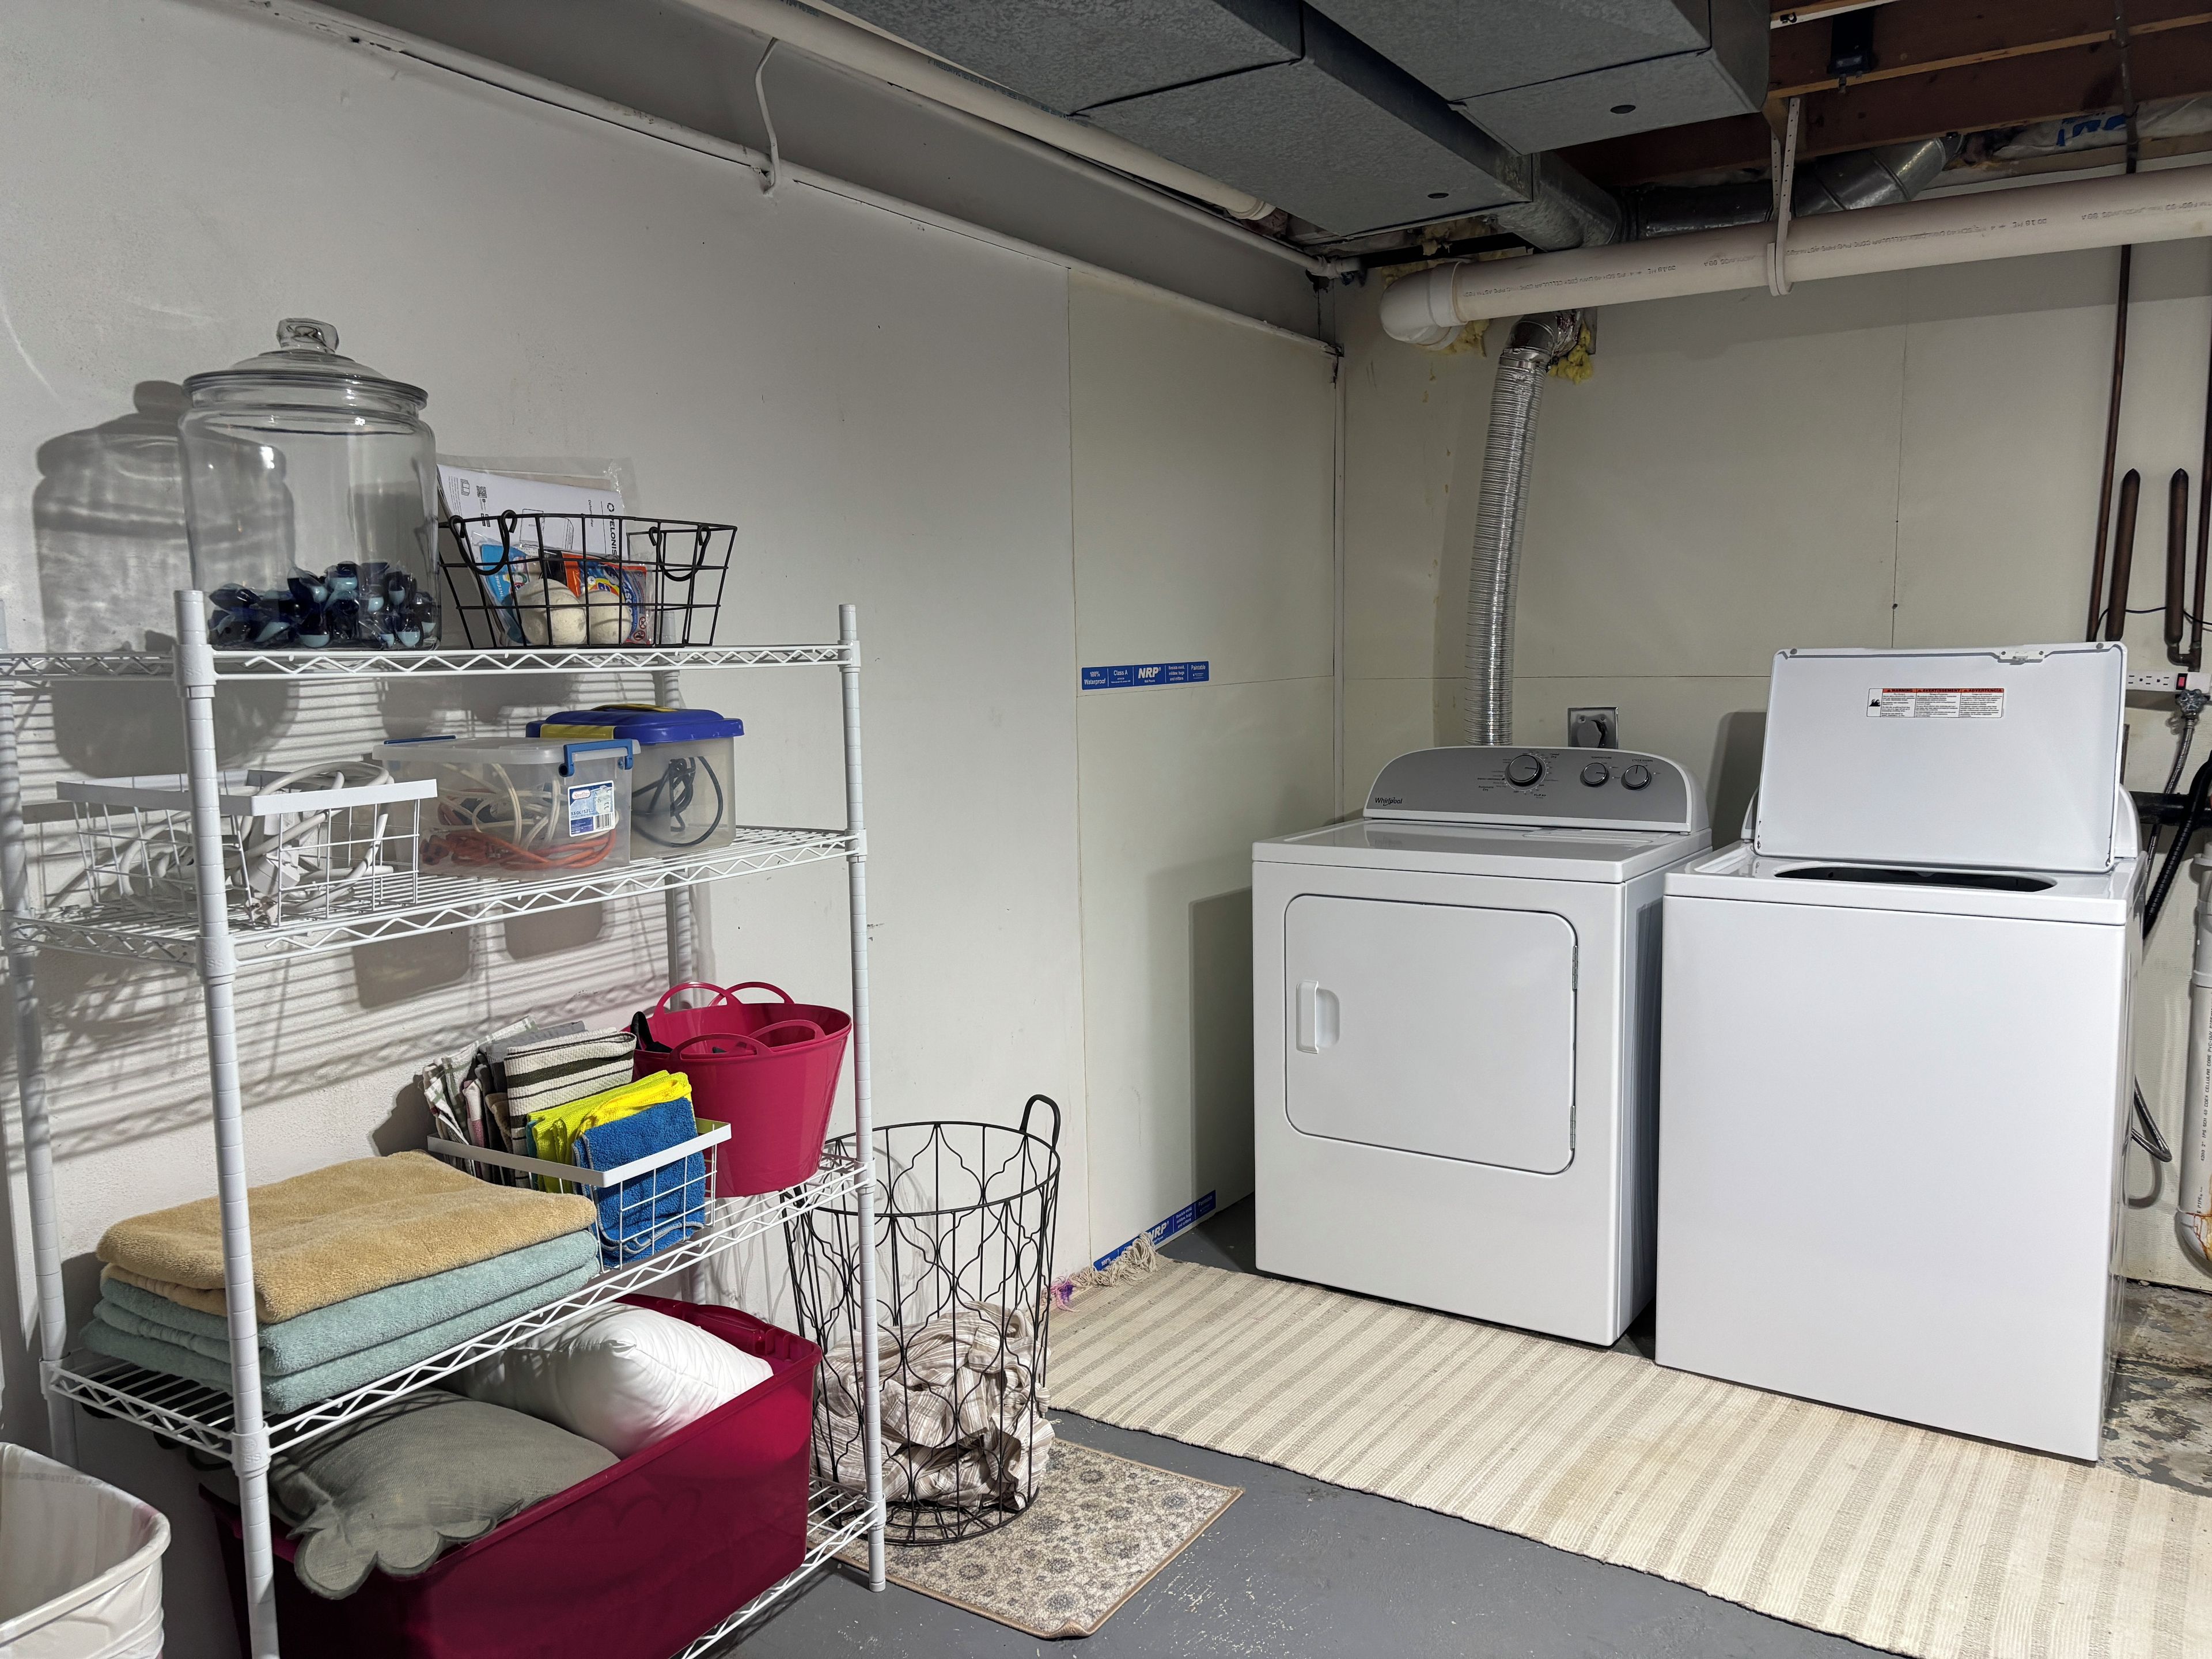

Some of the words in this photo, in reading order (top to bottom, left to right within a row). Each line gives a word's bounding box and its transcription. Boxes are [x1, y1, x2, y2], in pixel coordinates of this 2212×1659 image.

[1138, 667, 1161, 679] NRP
[1084, 678, 1106, 686] Waterproof
[1375, 797, 1403, 806] Whirlpool
